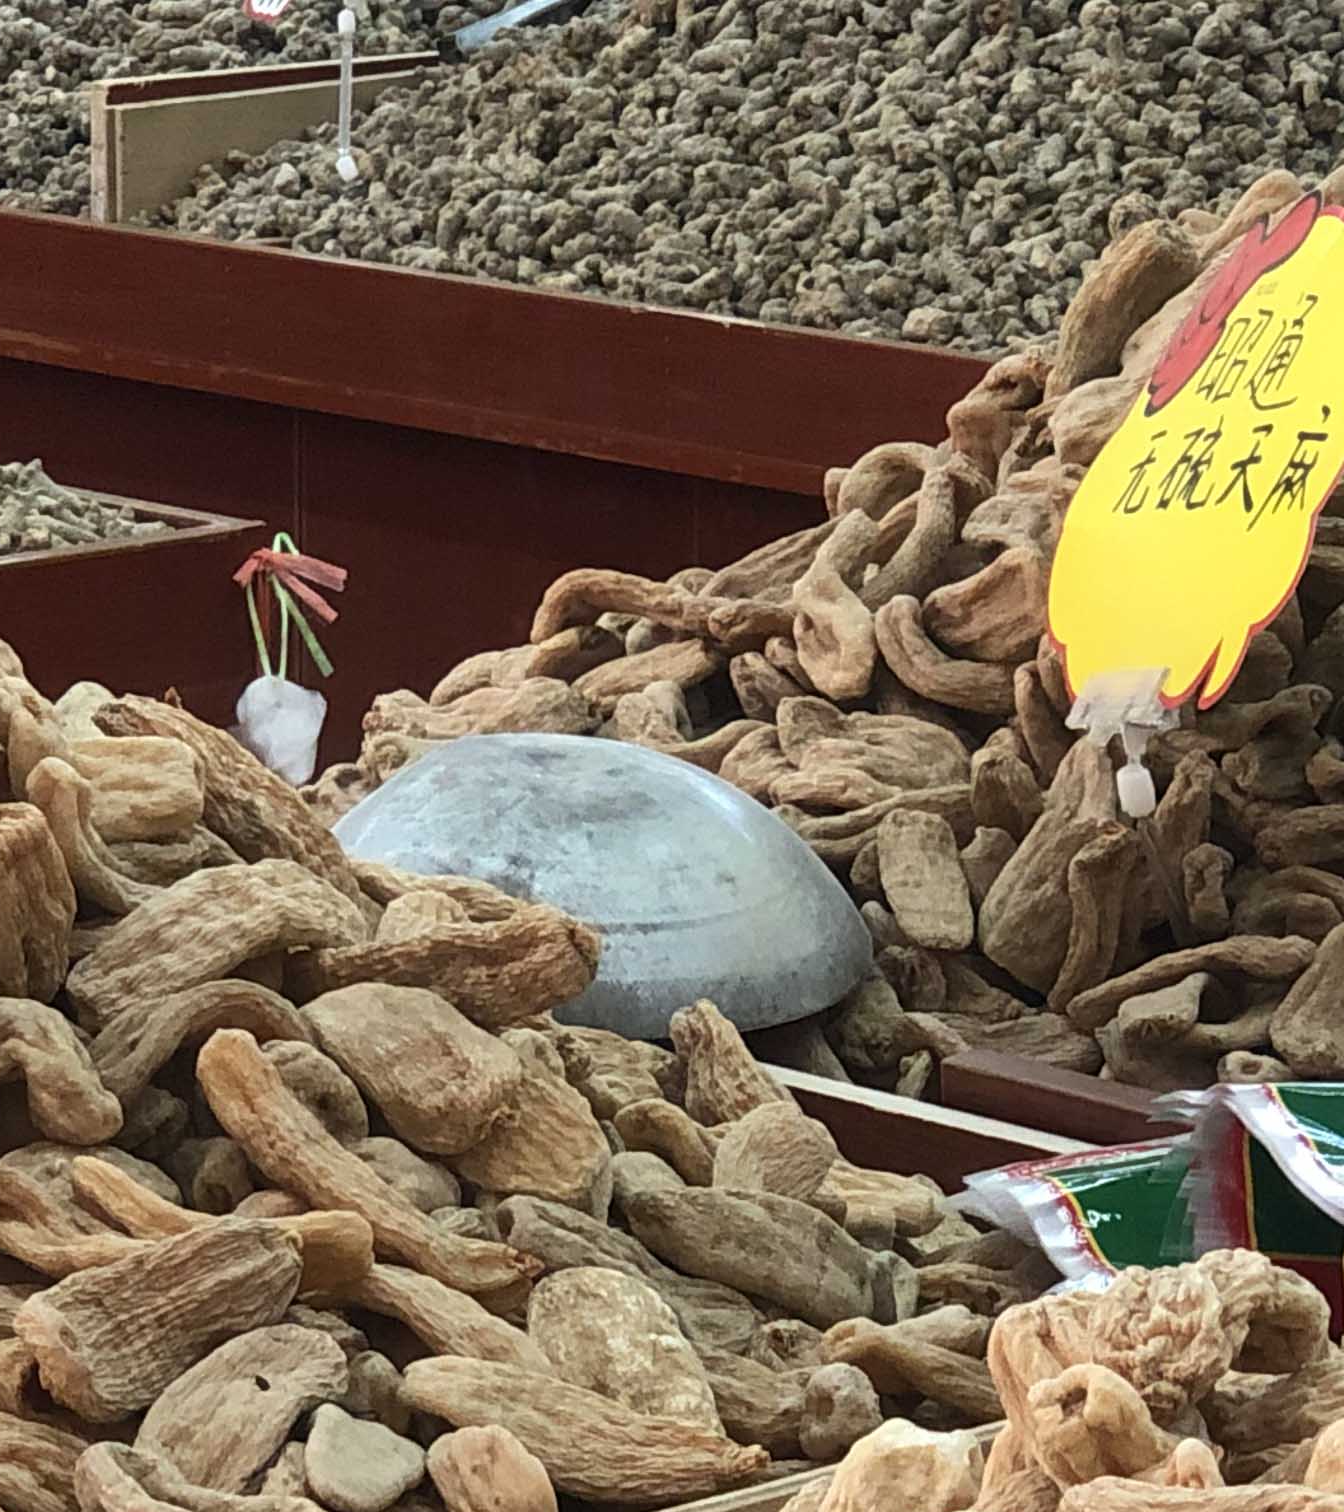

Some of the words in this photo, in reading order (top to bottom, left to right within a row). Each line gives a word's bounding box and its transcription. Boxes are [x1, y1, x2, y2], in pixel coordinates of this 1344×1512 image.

[1196, 294, 1318, 410] 昭通
[1111, 405, 1332, 532] 无硫天麻
